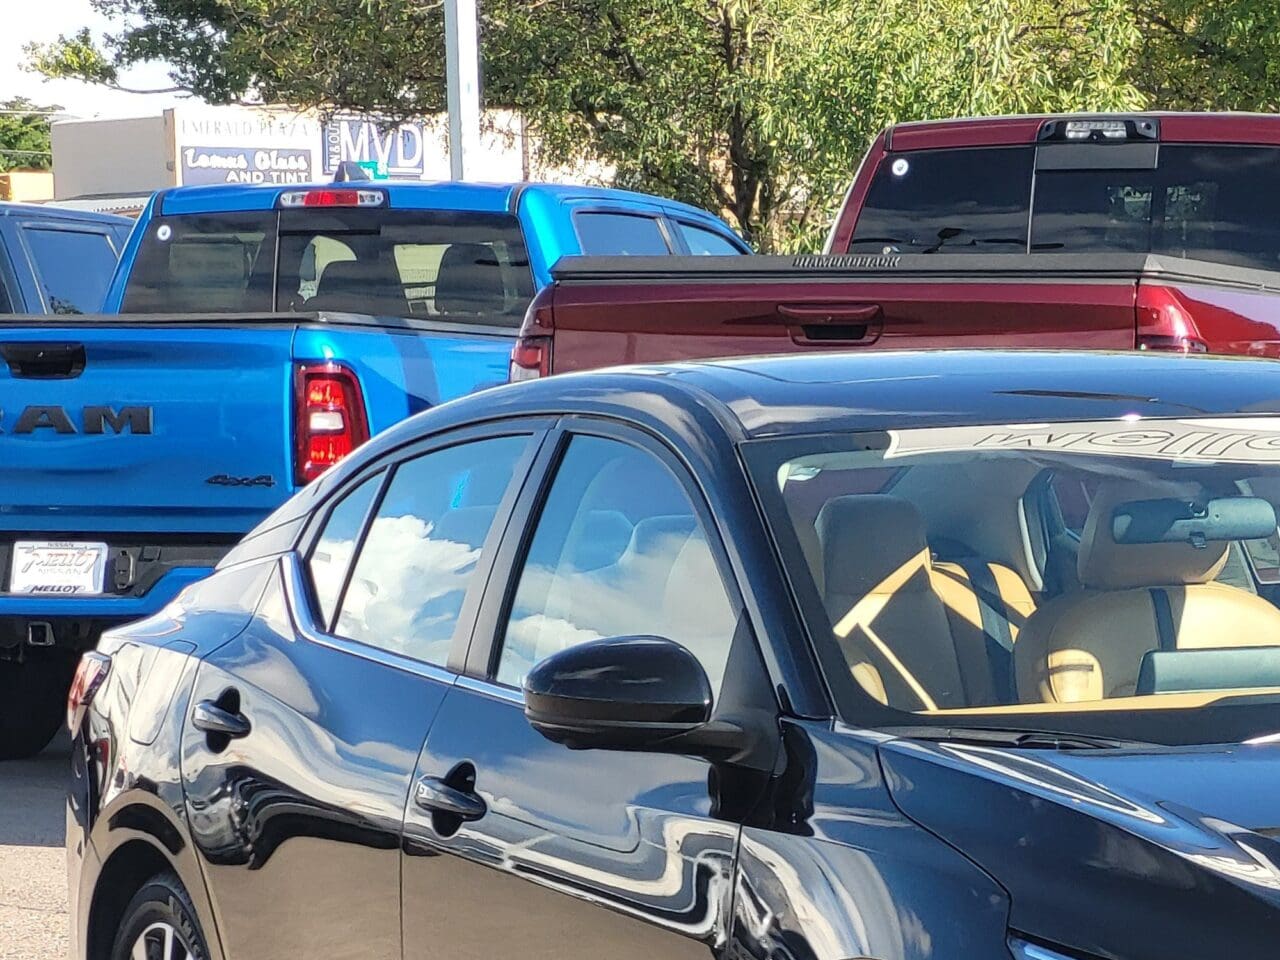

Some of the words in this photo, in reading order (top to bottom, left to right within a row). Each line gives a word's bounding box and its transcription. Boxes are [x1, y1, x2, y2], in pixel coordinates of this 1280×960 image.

[340, 120, 423, 168] MVD
[254, 150, 308, 170] Glass
[225, 170, 265, 183] AND
[268, 171, 309, 184] TINT
[0, 405, 153, 434] AM
[205, 474, 275, 487] 4x4
[30, 585, 81, 594] MELLOY
